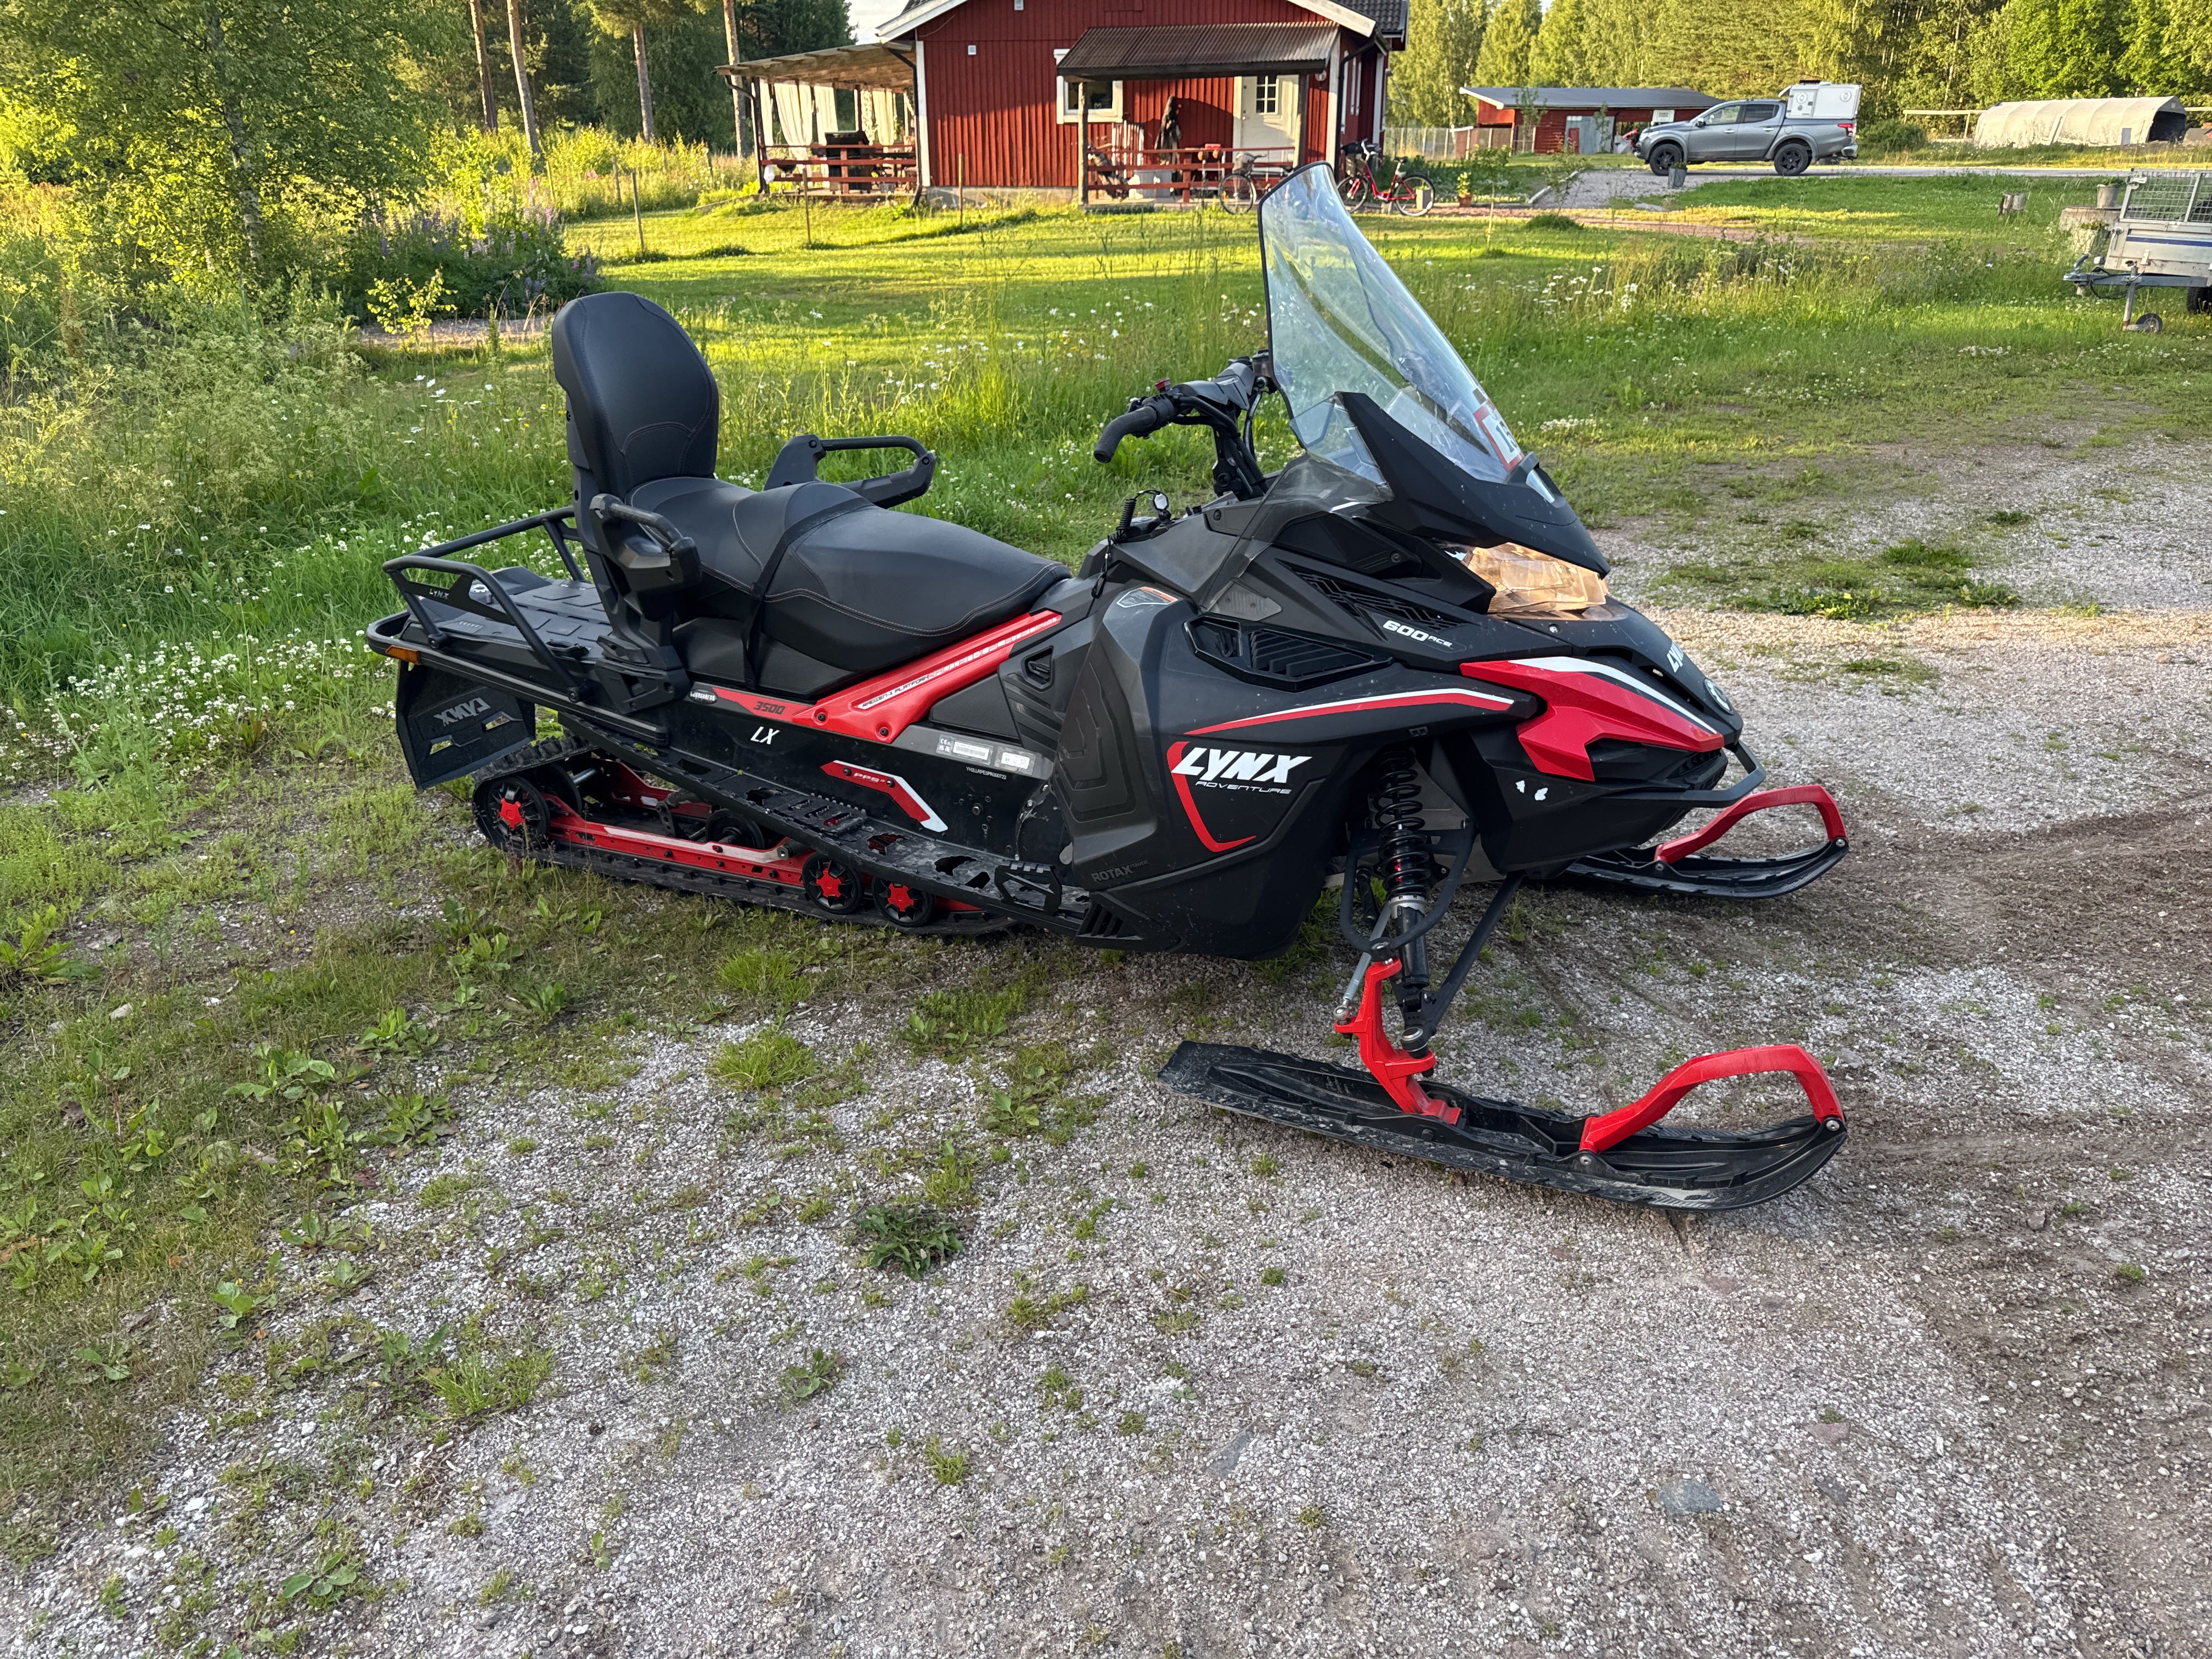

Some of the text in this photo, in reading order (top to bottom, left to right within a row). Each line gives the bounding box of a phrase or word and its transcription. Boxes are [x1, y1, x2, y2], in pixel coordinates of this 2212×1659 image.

[429, 588, 449, 600] LYNX
[1383, 620, 1453, 647] 600 ACE
[1667, 641, 1684, 673] LYN
[894, 675, 929, 695] PLATFORM
[753, 701, 786, 715] 3500
[751, 726, 780, 744] LX
[1171, 747, 1312, 783] LYNX
[1195, 781, 1292, 795] ADVENTURE
[1090, 865, 1133, 883] ROTAX
